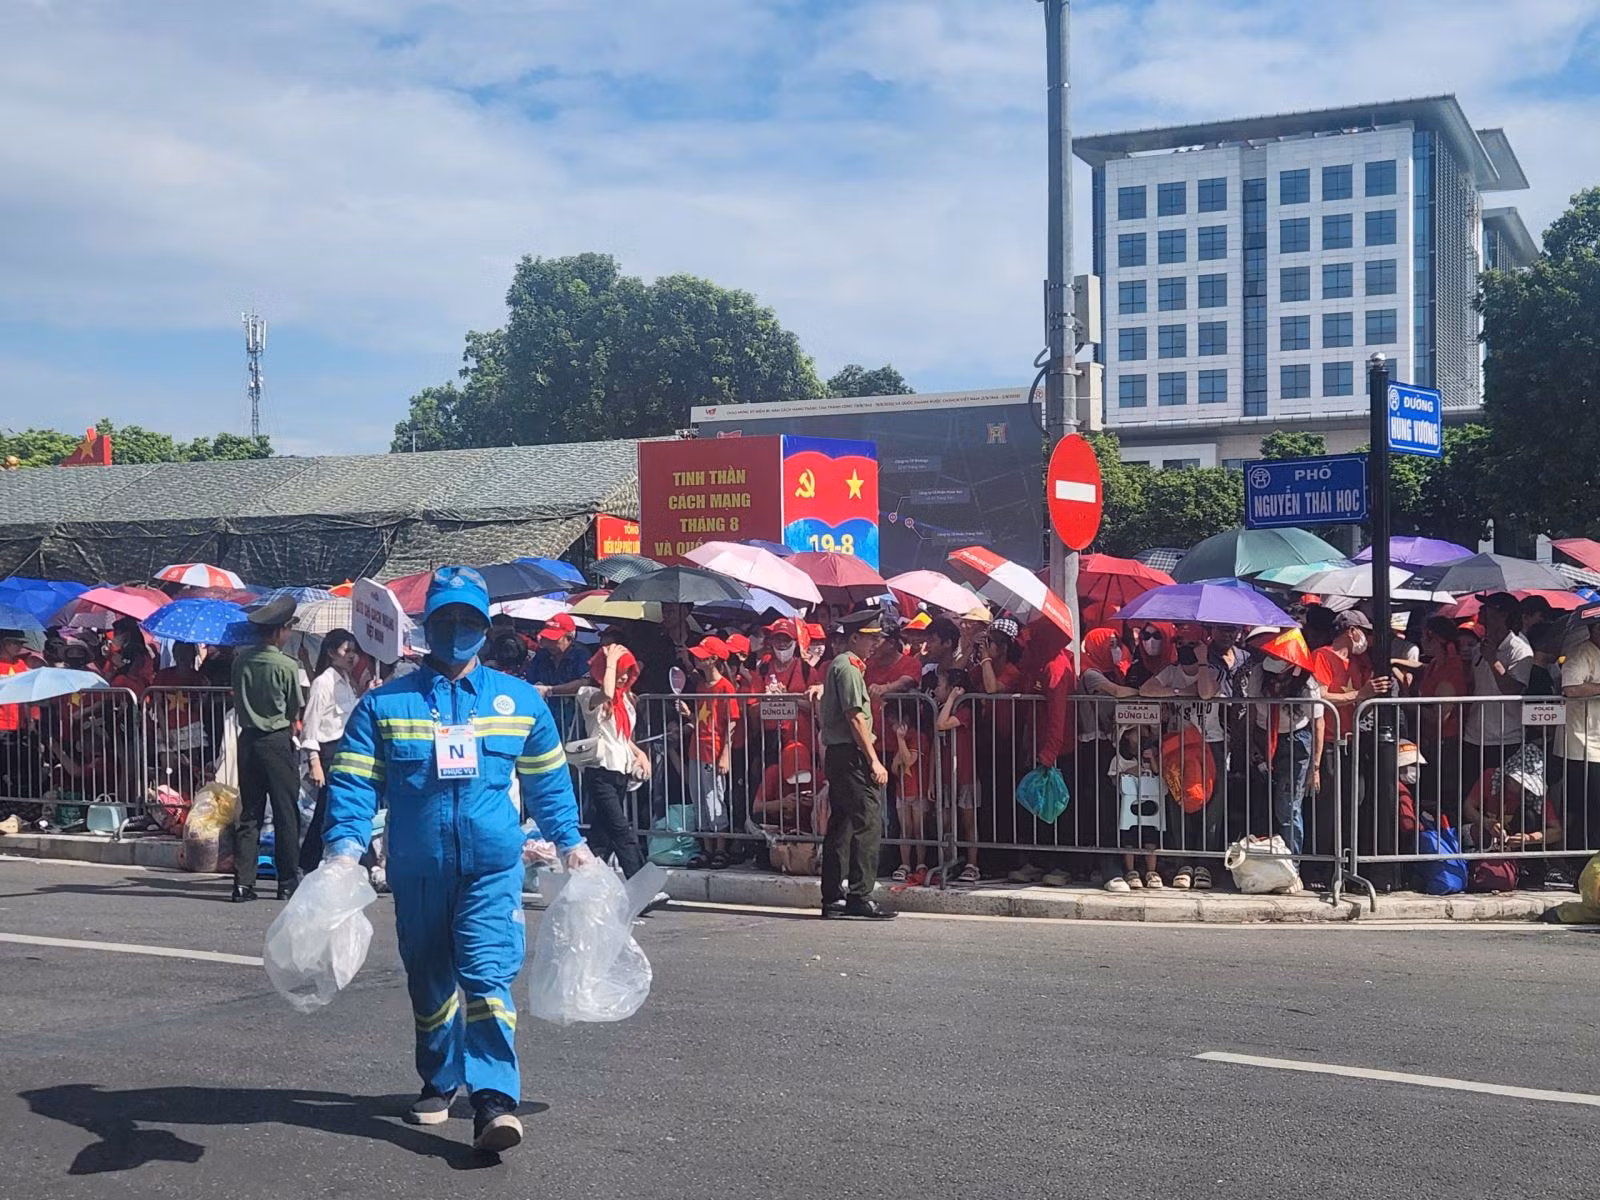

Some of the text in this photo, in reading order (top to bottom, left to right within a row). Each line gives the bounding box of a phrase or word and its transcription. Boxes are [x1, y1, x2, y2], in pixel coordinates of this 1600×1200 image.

[1404, 394, 1434, 413] ĐƯỜNG
[1391, 411, 1438, 446] HÙNG VƯƠNG
[672, 465, 746, 486] TINH THẦN
[1294, 462, 1333, 481] PHỐ
[668, 493, 751, 511] CÁCH MẠNG
[1254, 485, 1360, 517] NGUYỄN THÁI HỌC
[680, 516, 740, 533] THÁNG 8
[655, 539, 673, 556] VÀ
[809, 533, 854, 555] 19-8
[1531, 713, 1558, 722] STOP
[449, 744, 465, 760] N
